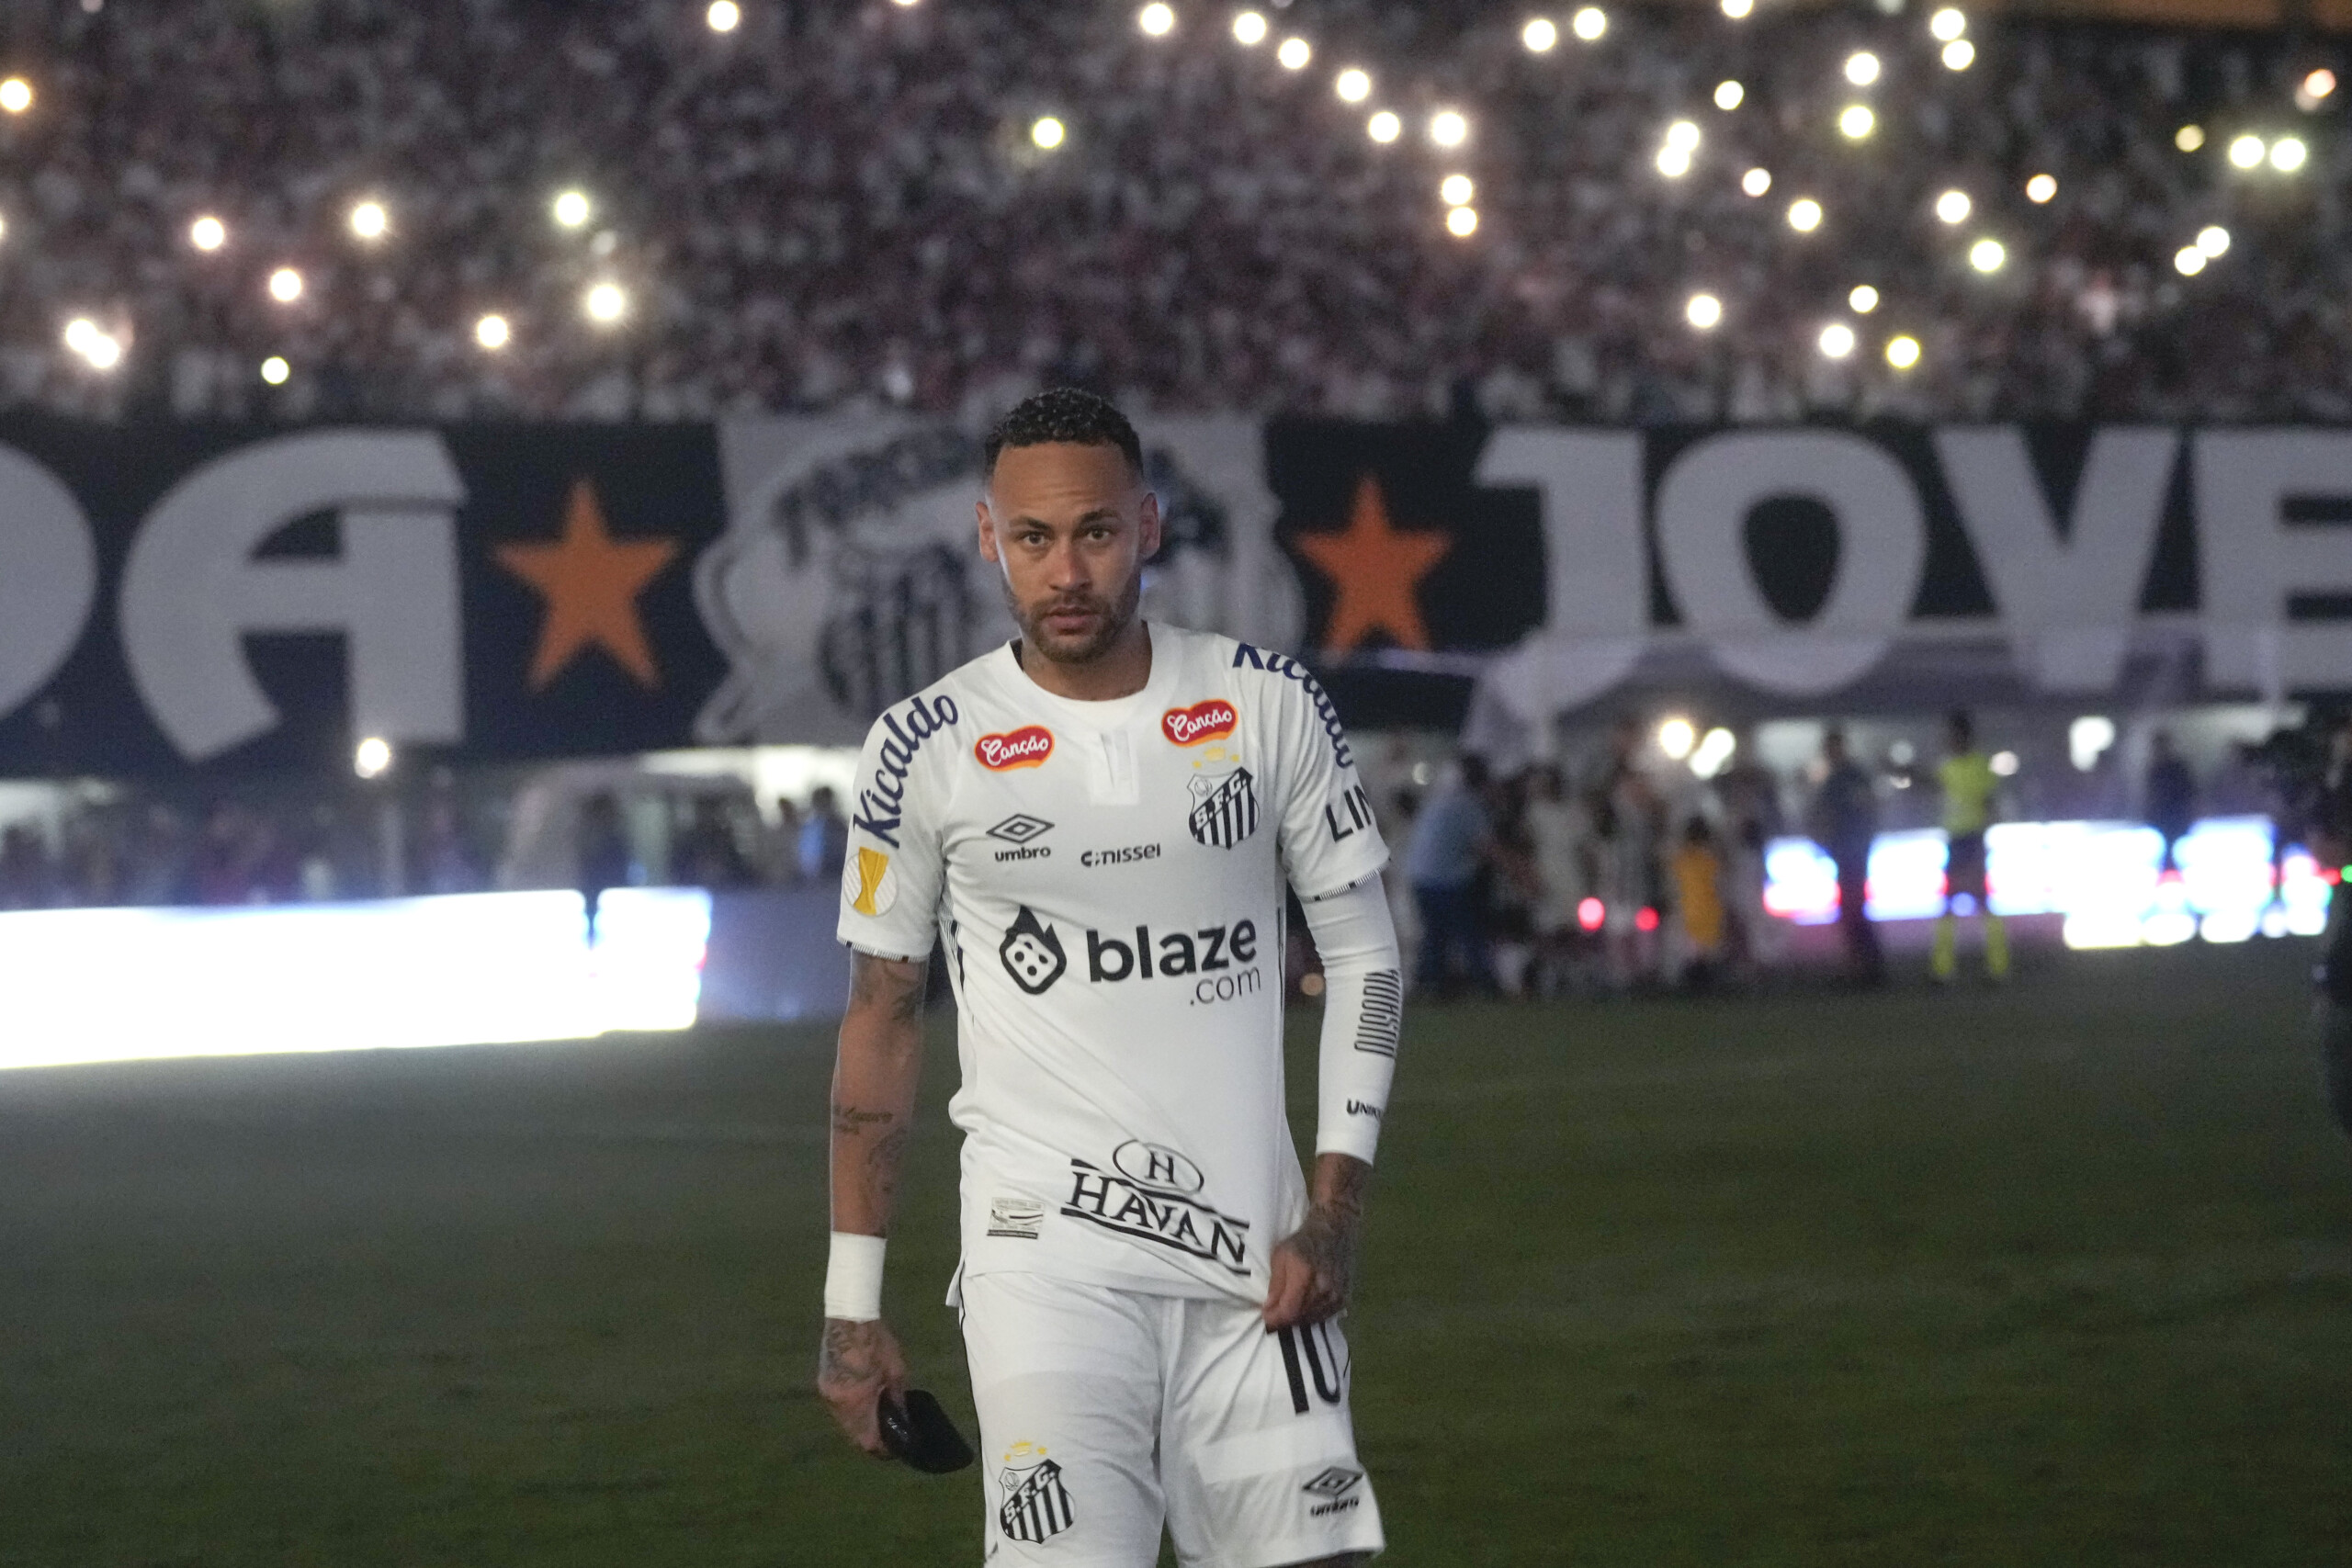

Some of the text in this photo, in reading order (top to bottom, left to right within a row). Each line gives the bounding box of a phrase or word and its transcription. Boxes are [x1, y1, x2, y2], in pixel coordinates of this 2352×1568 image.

[1167, 709, 1232, 742] Canção
[981, 735, 1049, 766] Canção
[854, 695, 958, 850] Kicaldo
[995, 846, 1051, 862] umbro
[1086, 919, 1257, 983] blaze
[1190, 966, 1261, 1006] .com
[1145, 1150, 1176, 1184] H
[1066, 1171, 1245, 1264] HAVAN
